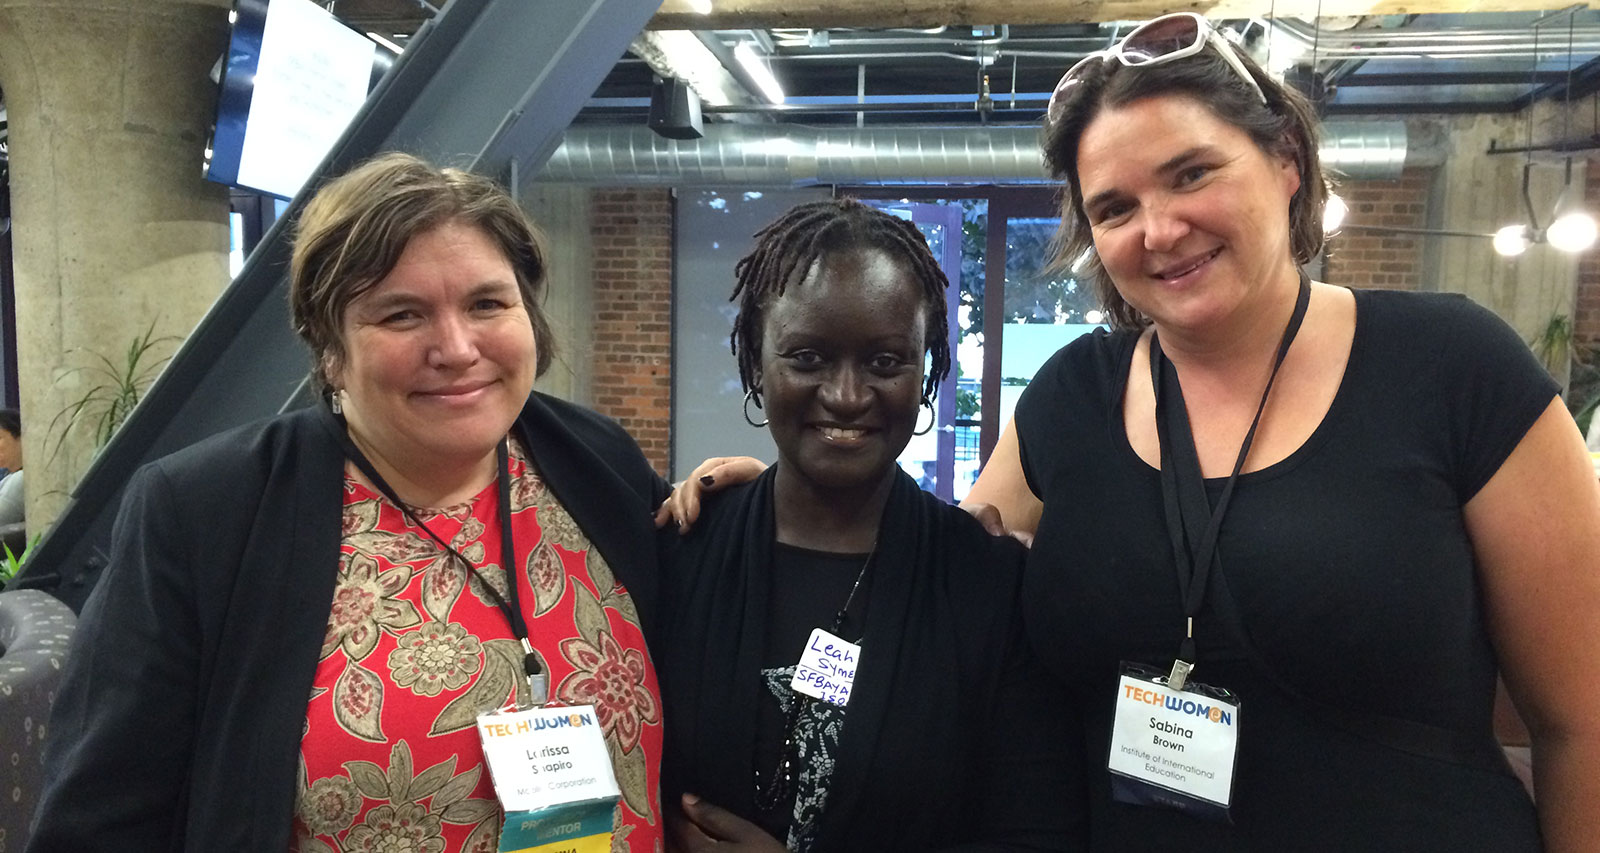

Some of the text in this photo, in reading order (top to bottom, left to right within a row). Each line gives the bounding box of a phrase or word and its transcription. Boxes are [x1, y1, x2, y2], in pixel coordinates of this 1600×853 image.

[811, 635, 853, 662] Leah
[1149, 717, 1193, 739] Sabina
[1153, 735, 1185, 752] Brown
[1121, 745, 1215, 779] Institute of International
[1145, 763, 1186, 782] Education
[548, 777, 597, 790] Corporation
